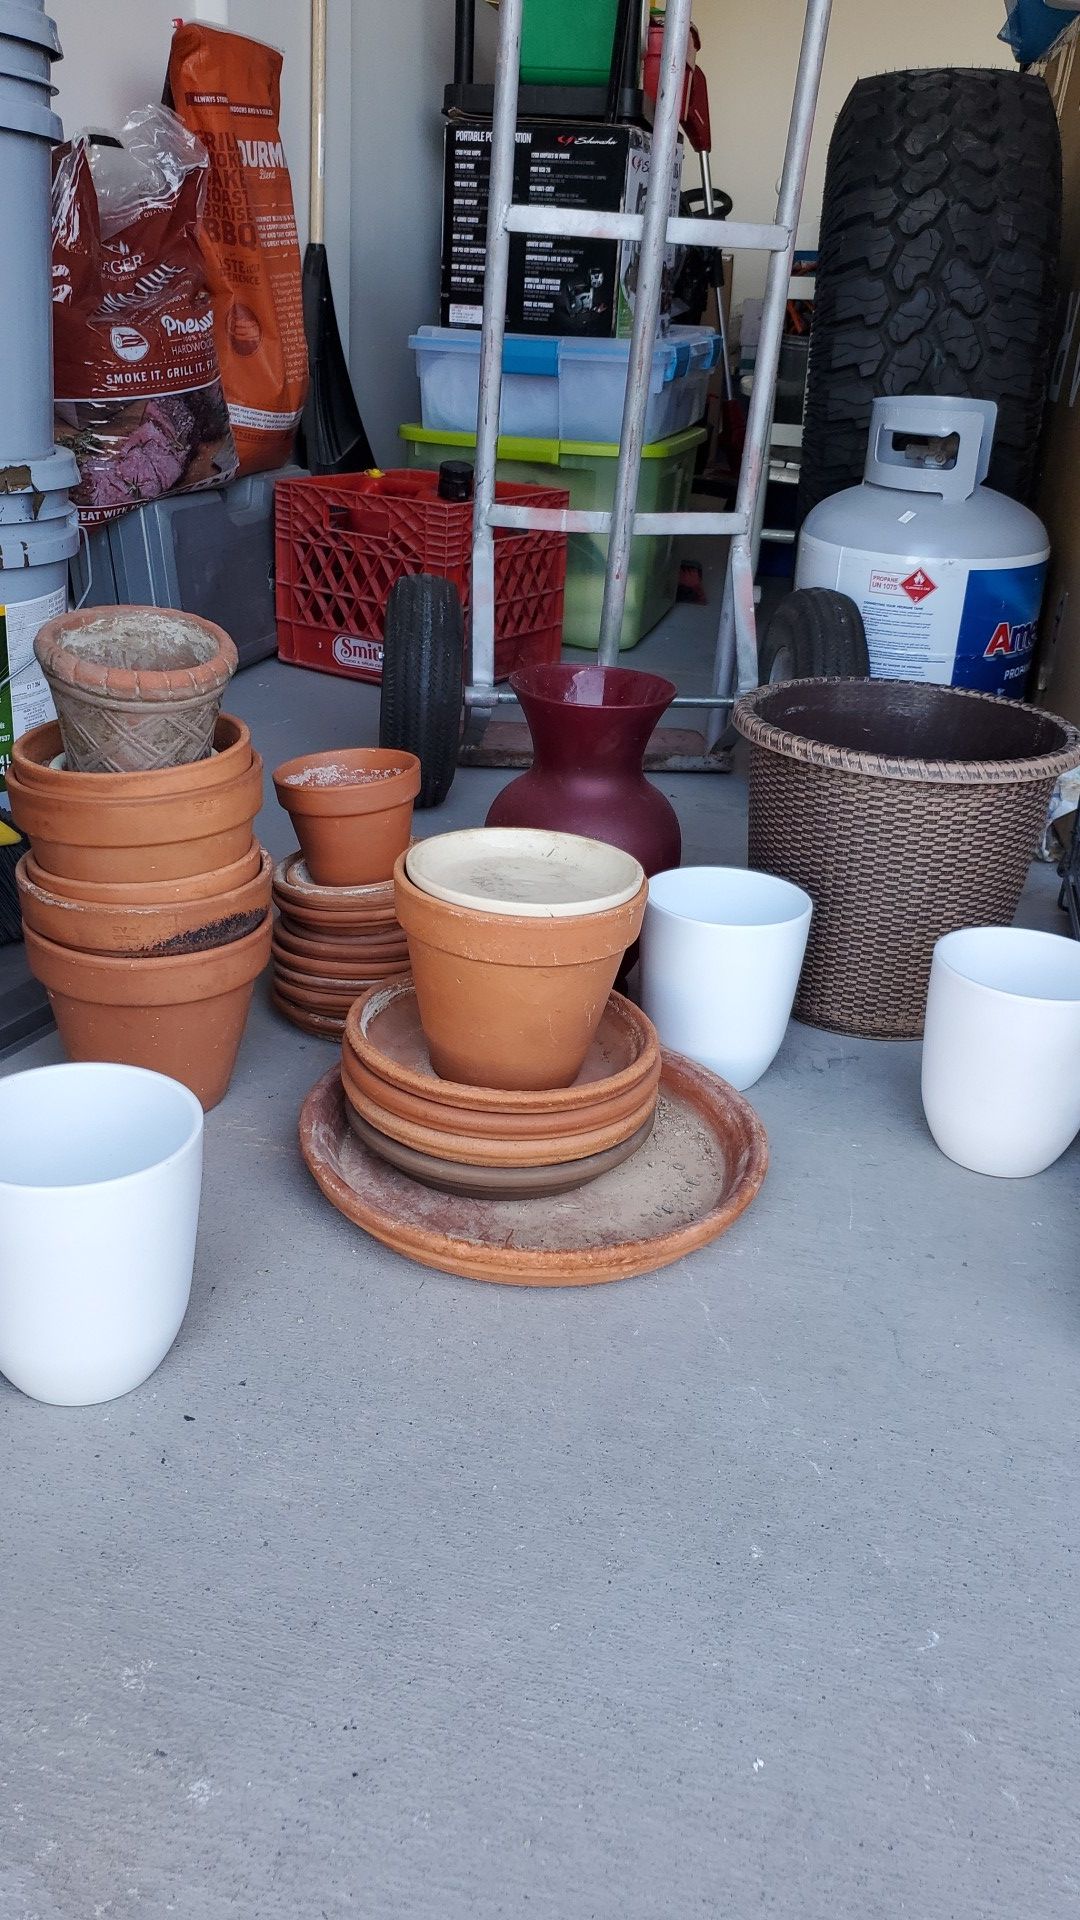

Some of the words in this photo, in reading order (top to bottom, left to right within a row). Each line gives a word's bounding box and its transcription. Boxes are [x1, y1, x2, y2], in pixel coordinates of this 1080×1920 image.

[193, 95, 216, 104] ALWAYS
[455, 130, 484, 142] PORTABLE
[202, 218, 257, 251] BBQ
[105, 371, 148, 385] SMOKE
[150, 369, 164, 381] IT.
[166, 364, 194, 379] GRILL
[195, 361, 206, 374] IT.
[872, 575, 899, 584] PROPANE
[871, 581, 882, 589] UN
[883, 583, 898, 591] 1075
[340, 638, 384, 662] Smit
